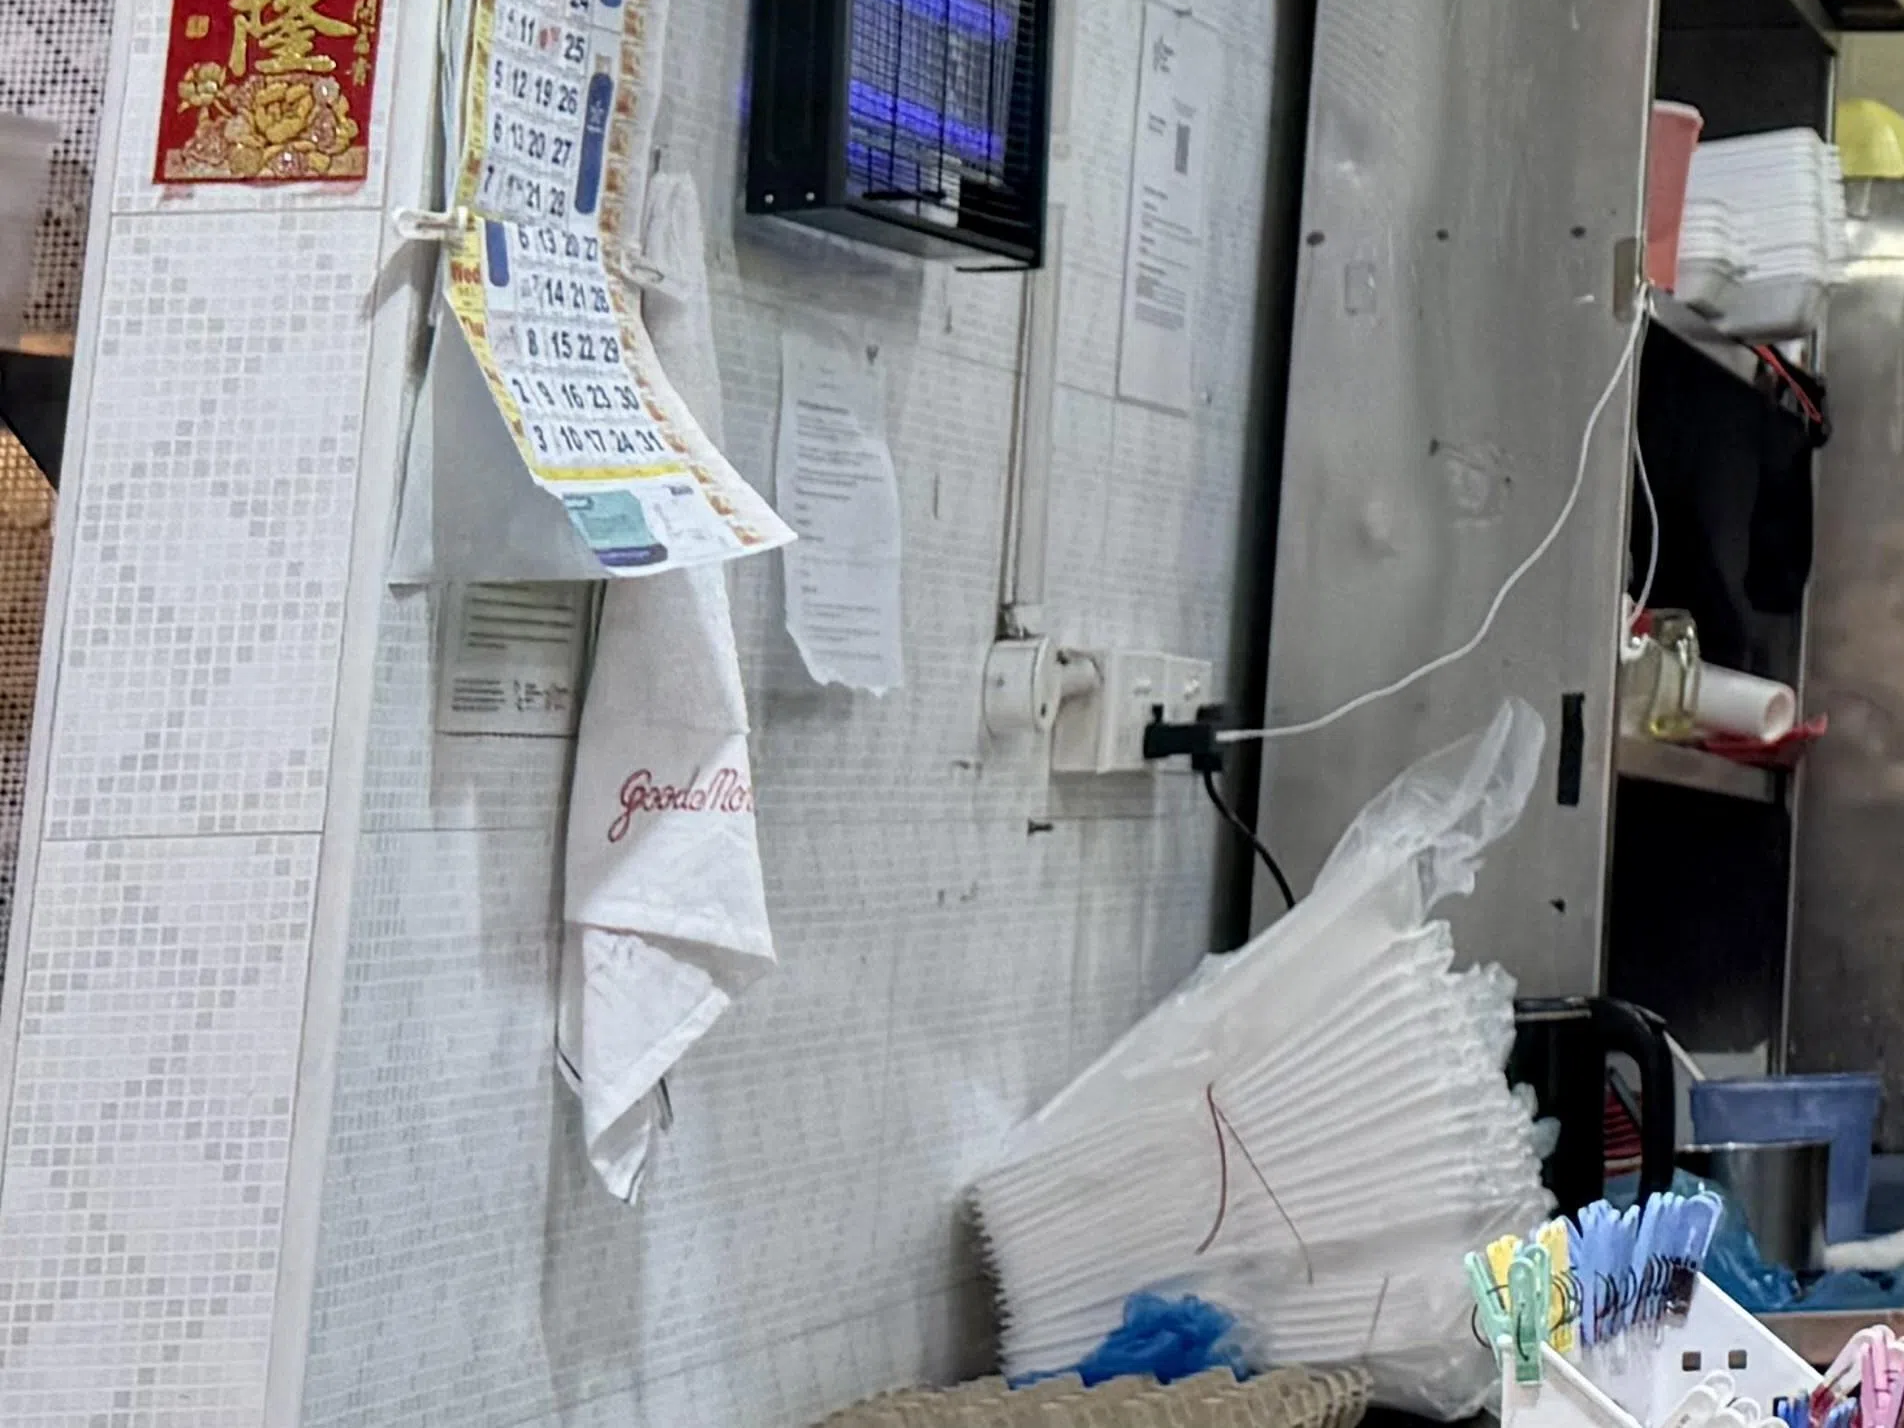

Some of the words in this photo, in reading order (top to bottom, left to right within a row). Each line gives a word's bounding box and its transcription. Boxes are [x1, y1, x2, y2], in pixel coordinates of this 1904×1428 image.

[564, 33, 585, 63] 25
[551, 137, 572, 167] 27
[546, 278, 564, 306] 14
[527, 328, 538, 357] 8
[551, 331, 573, 359] 15
[577, 333, 596, 361] 22
[561, 384, 584, 409] 16
[586, 385, 612, 409] 23
[614, 385, 640, 410] 30
[559, 426, 584, 451] 10
[584, 428, 607, 452] 17
[609, 429, 636, 453] 24
[635, 429, 665, 452] 31
